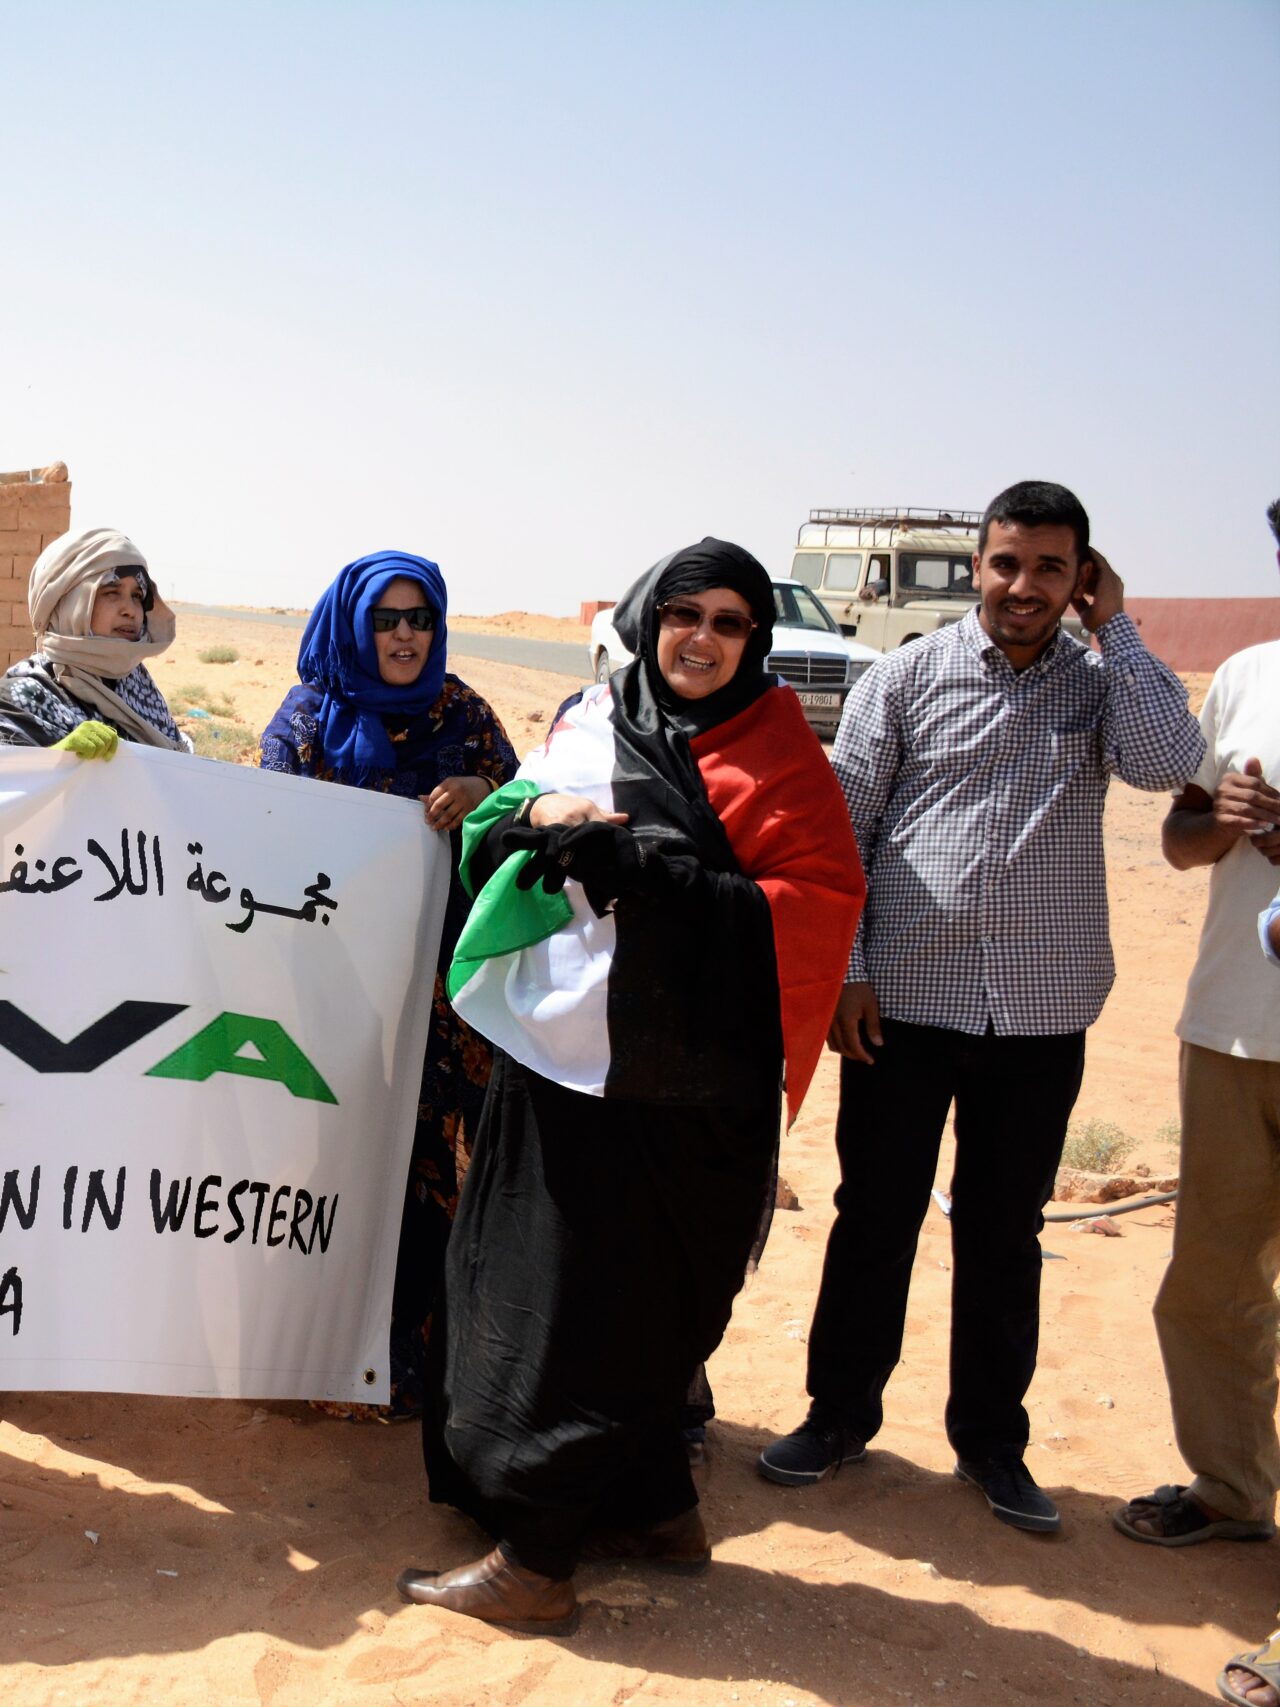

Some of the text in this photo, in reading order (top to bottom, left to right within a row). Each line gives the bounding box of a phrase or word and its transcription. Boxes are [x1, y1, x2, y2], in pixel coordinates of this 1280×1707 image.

[186, 841, 339, 934] مجموعة
[62, 1165, 126, 1233] IN
[149, 1168, 340, 1256] WESTERN
